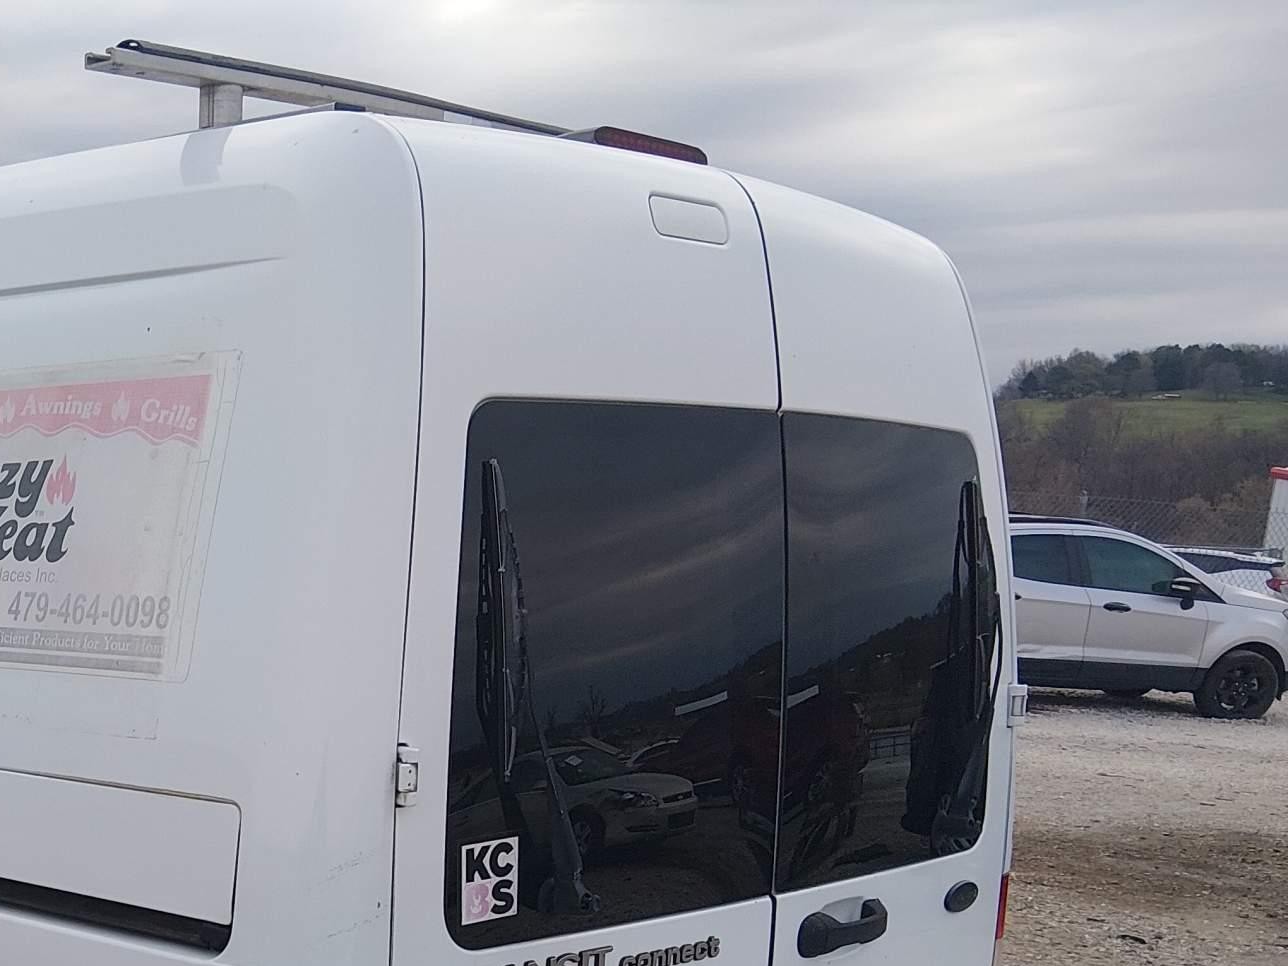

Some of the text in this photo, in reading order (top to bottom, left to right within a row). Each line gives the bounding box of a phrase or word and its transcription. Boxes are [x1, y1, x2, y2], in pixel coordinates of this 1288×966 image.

[20, 394, 102, 418] Awnings
[140, 399, 199, 432] Grills
[35, 567, 59, 583] Inc.
[7, 591, 171, 629] 479-464-0098
[32, 631, 81, 649] Products
[82, 634, 99, 651] for
[104, 635, 129, 652] Your
[465, 841, 514, 883] KC
